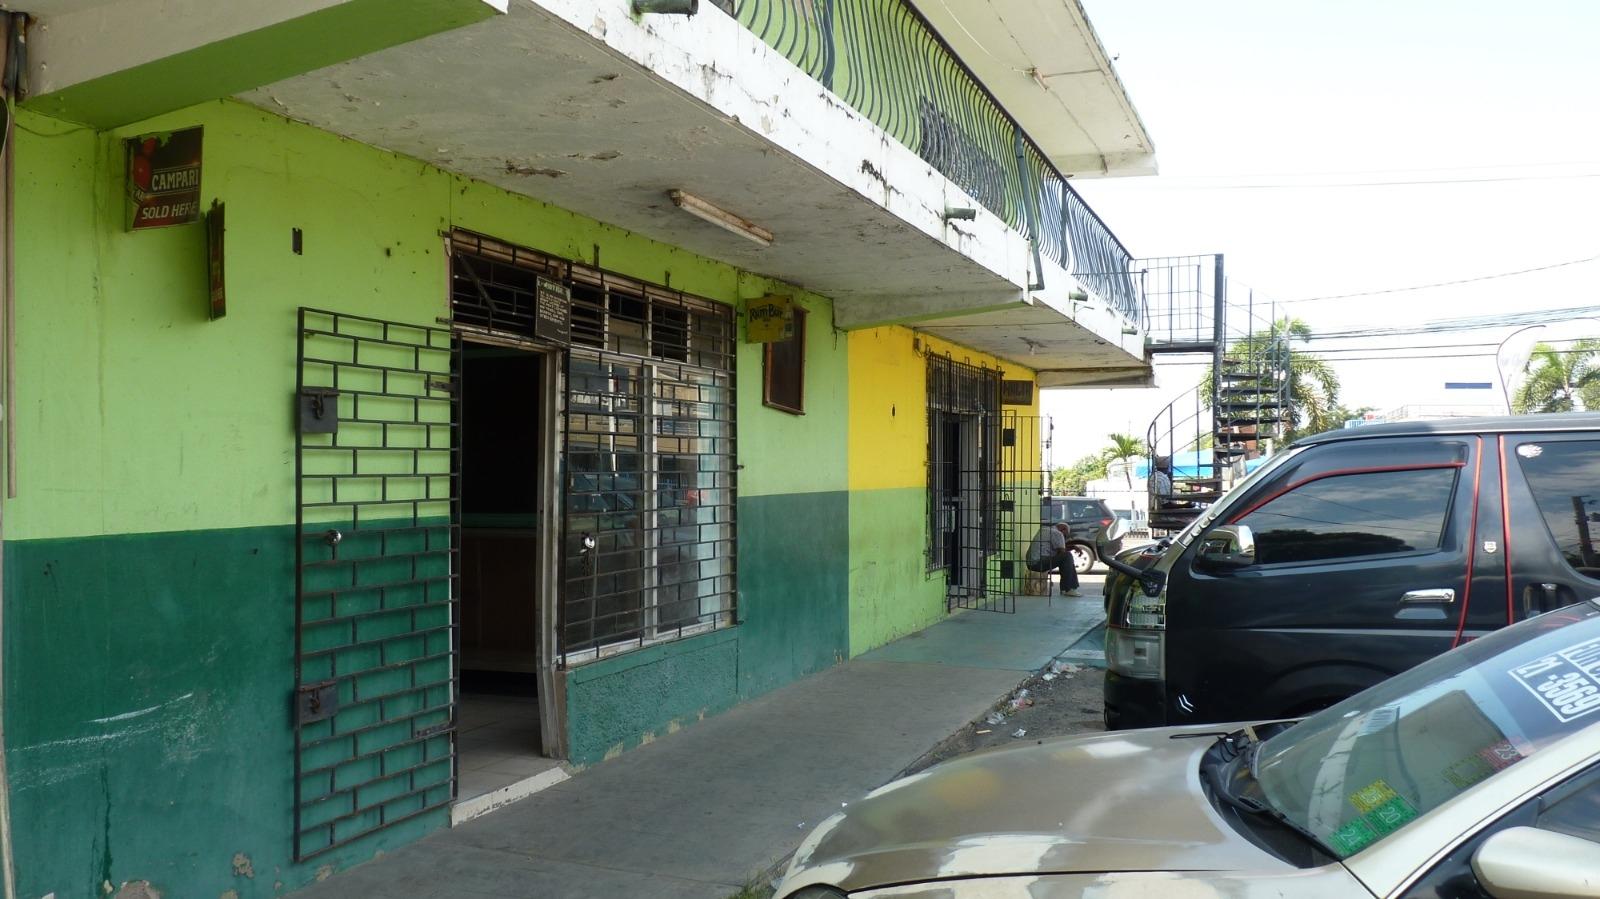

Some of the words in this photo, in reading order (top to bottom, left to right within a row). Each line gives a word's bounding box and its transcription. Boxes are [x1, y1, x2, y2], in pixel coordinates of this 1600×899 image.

[151, 169, 199, 191] CAMPARI
[141, 205, 169, 219] SOLD
[171, 201, 198, 217] HERE
[1379, 806, 1401, 823] 20
